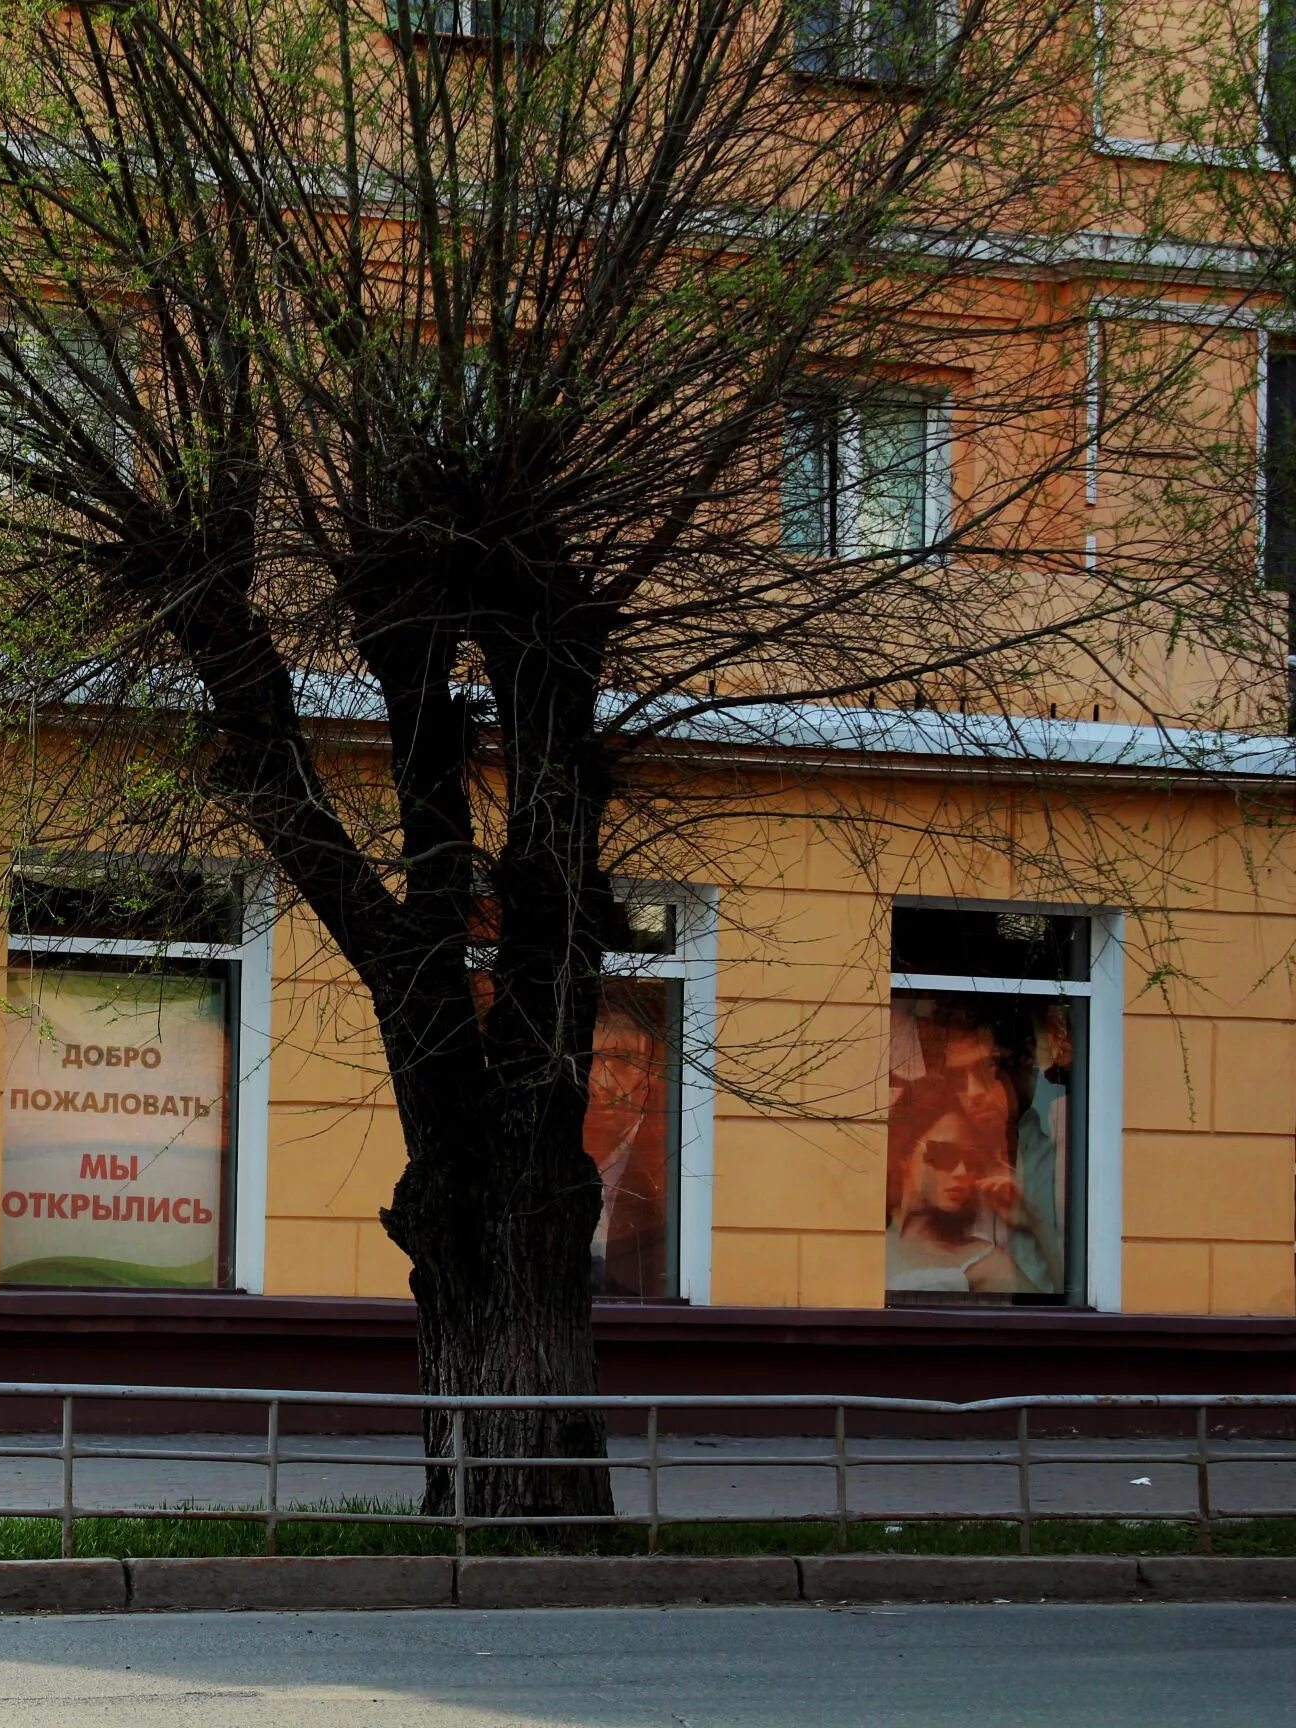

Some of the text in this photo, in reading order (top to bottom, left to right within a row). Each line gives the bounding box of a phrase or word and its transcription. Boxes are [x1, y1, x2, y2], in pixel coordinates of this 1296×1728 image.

[62, 1043, 162, 1069] ДОБРО
[10, 1088, 211, 1117] ПОЖАЛОВАТЬ
[79, 1152, 138, 1181] МЫ
[1, 1190, 213, 1224] ОТКРЫЛИСЬ
